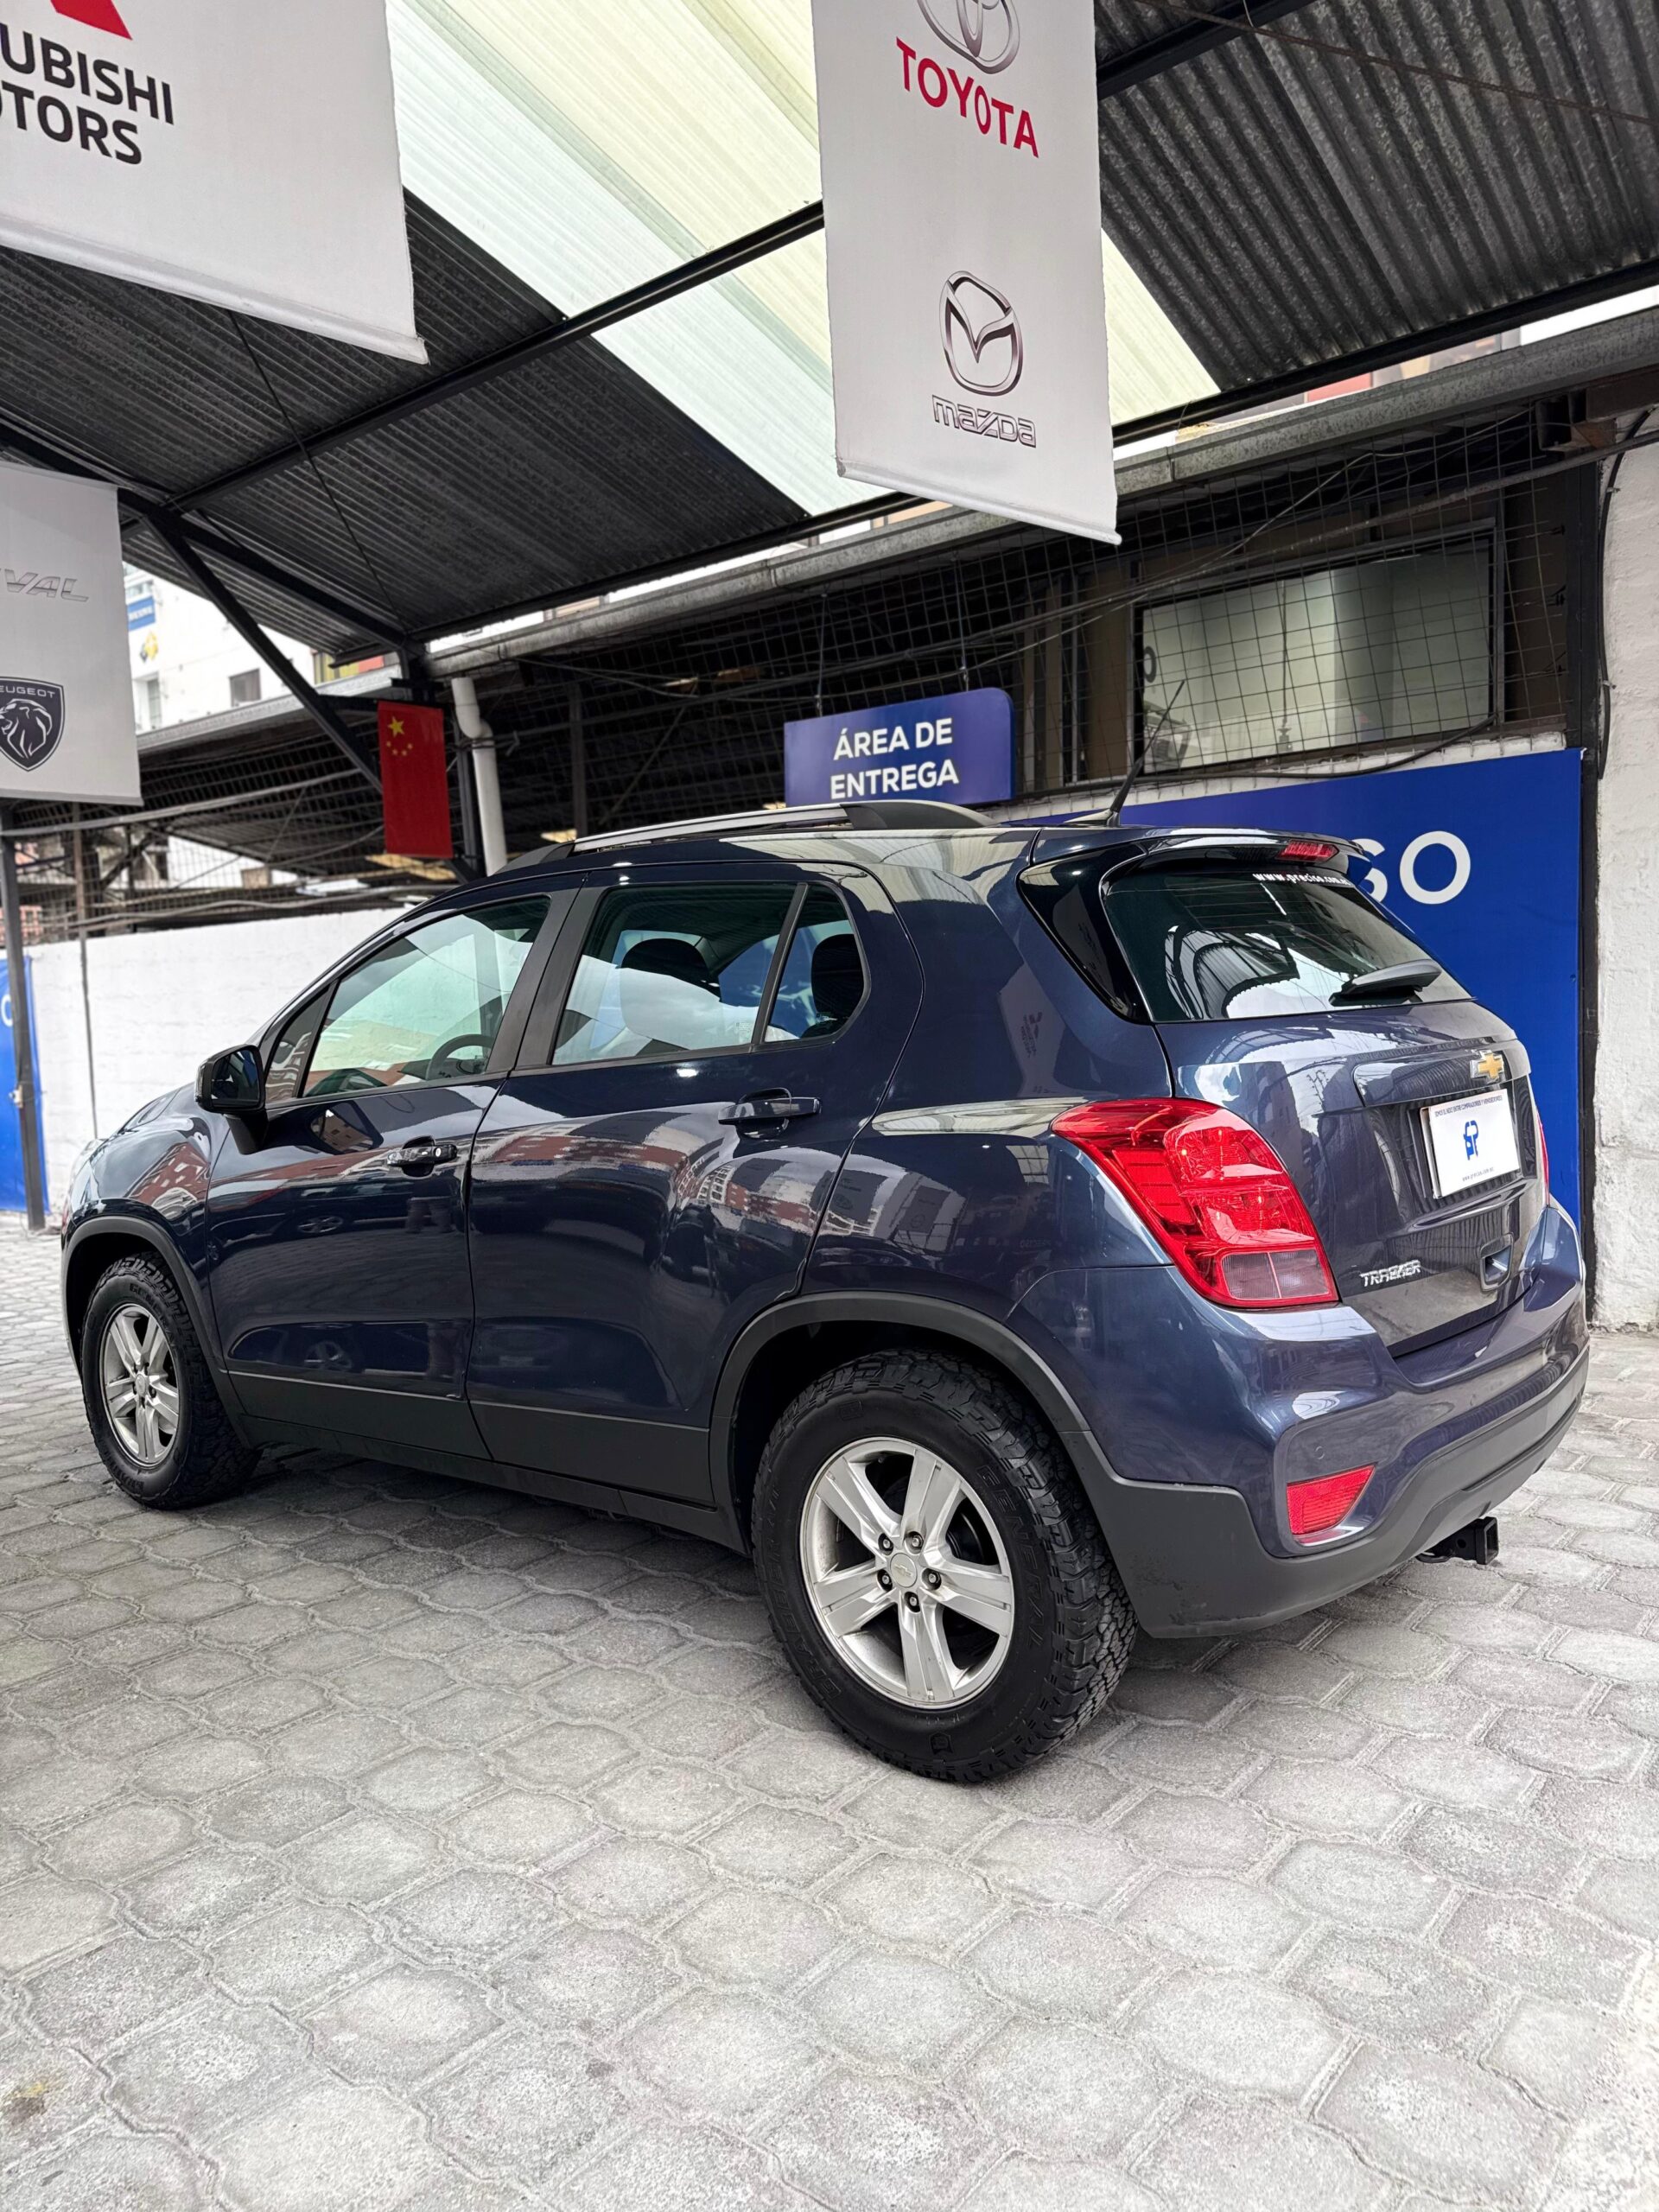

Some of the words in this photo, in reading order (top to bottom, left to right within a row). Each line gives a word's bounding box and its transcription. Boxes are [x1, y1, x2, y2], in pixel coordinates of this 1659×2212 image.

[0, 22, 174, 125] UBISHI
[896, 36, 1039, 158] TOYOTA
[0, 80, 143, 165] TORS
[830, 759, 959, 799] ENTREGA
[833, 726, 910, 761] ÁREA
[915, 717, 953, 748] DE
